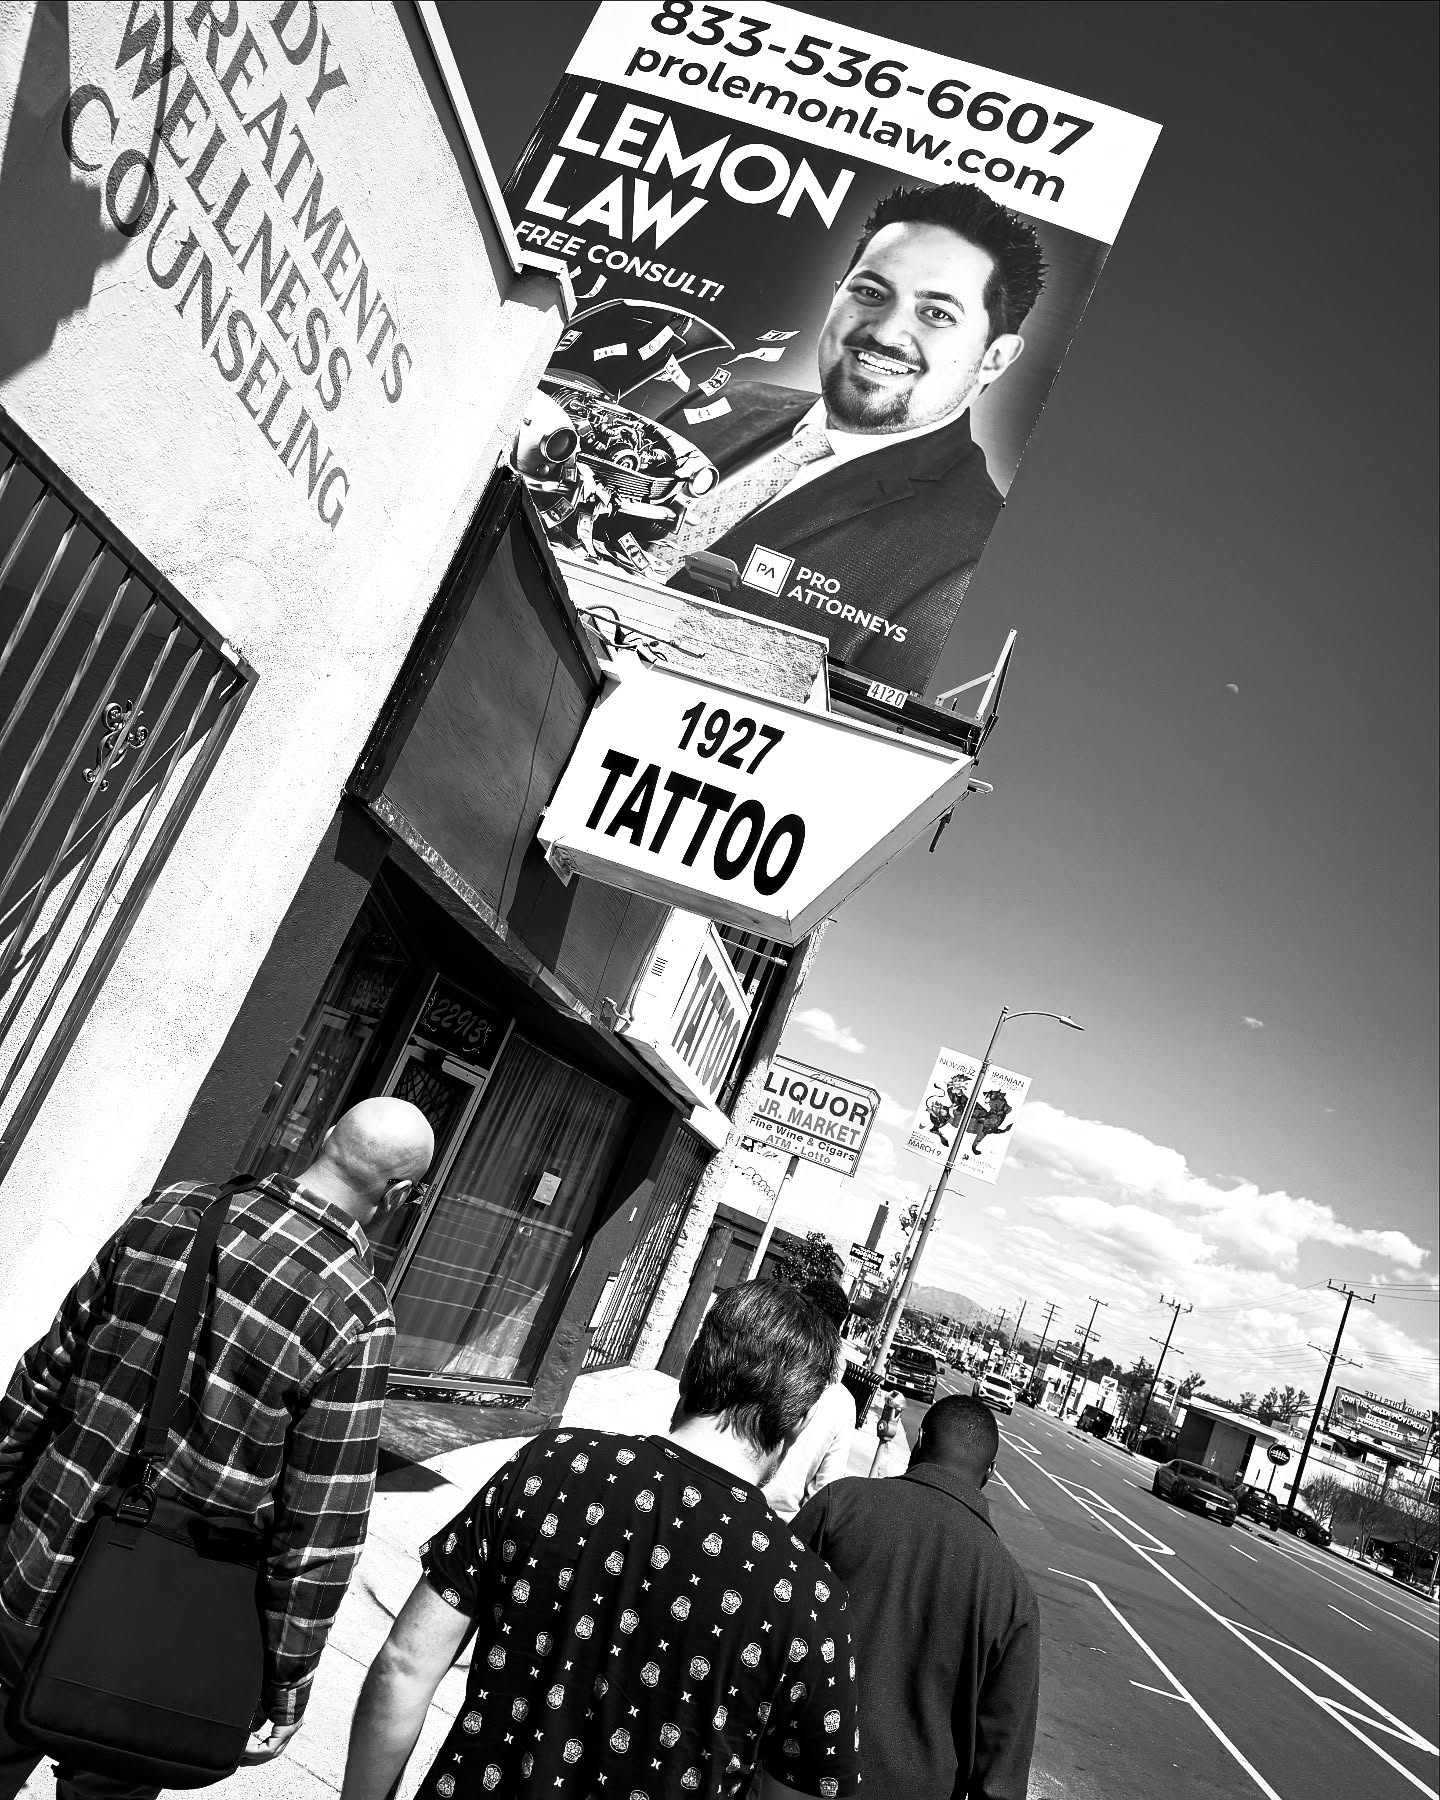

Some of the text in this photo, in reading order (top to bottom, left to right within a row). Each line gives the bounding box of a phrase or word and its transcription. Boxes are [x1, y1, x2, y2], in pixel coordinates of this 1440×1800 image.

[651, 0, 1095, 156] 833-536-6607
[559, 92, 856, 229] LEMON
[624, 46, 1066, 203] prolemonlaw.com
[115, 0, 351, 412] WELLNESS
[525, 153, 710, 250] LAW
[514, 220, 724, 302] FREE CONSULT!
[61, 84, 350, 531] COUNSELING
[787, 585, 908, 643] ATTORNEYS
[796, 566, 841, 594] PRO
[871, 683, 905, 707] 4120
[677, 702, 785, 774] 1927
[585, 749, 806, 896] TATTOO
[672, 954, 741, 1095] TATTOO
[764, 1072, 869, 1126] LIQUOR
[991, 1071, 1025, 1088] IRANIAN
[750, 1116, 855, 1162] Fine Wine & Cigars
[758, 1097, 861, 1146] JR. MARKET
[765, 1134, 831, 1164] ATM Lotto
[907, 1139, 936, 1155] MARCH
